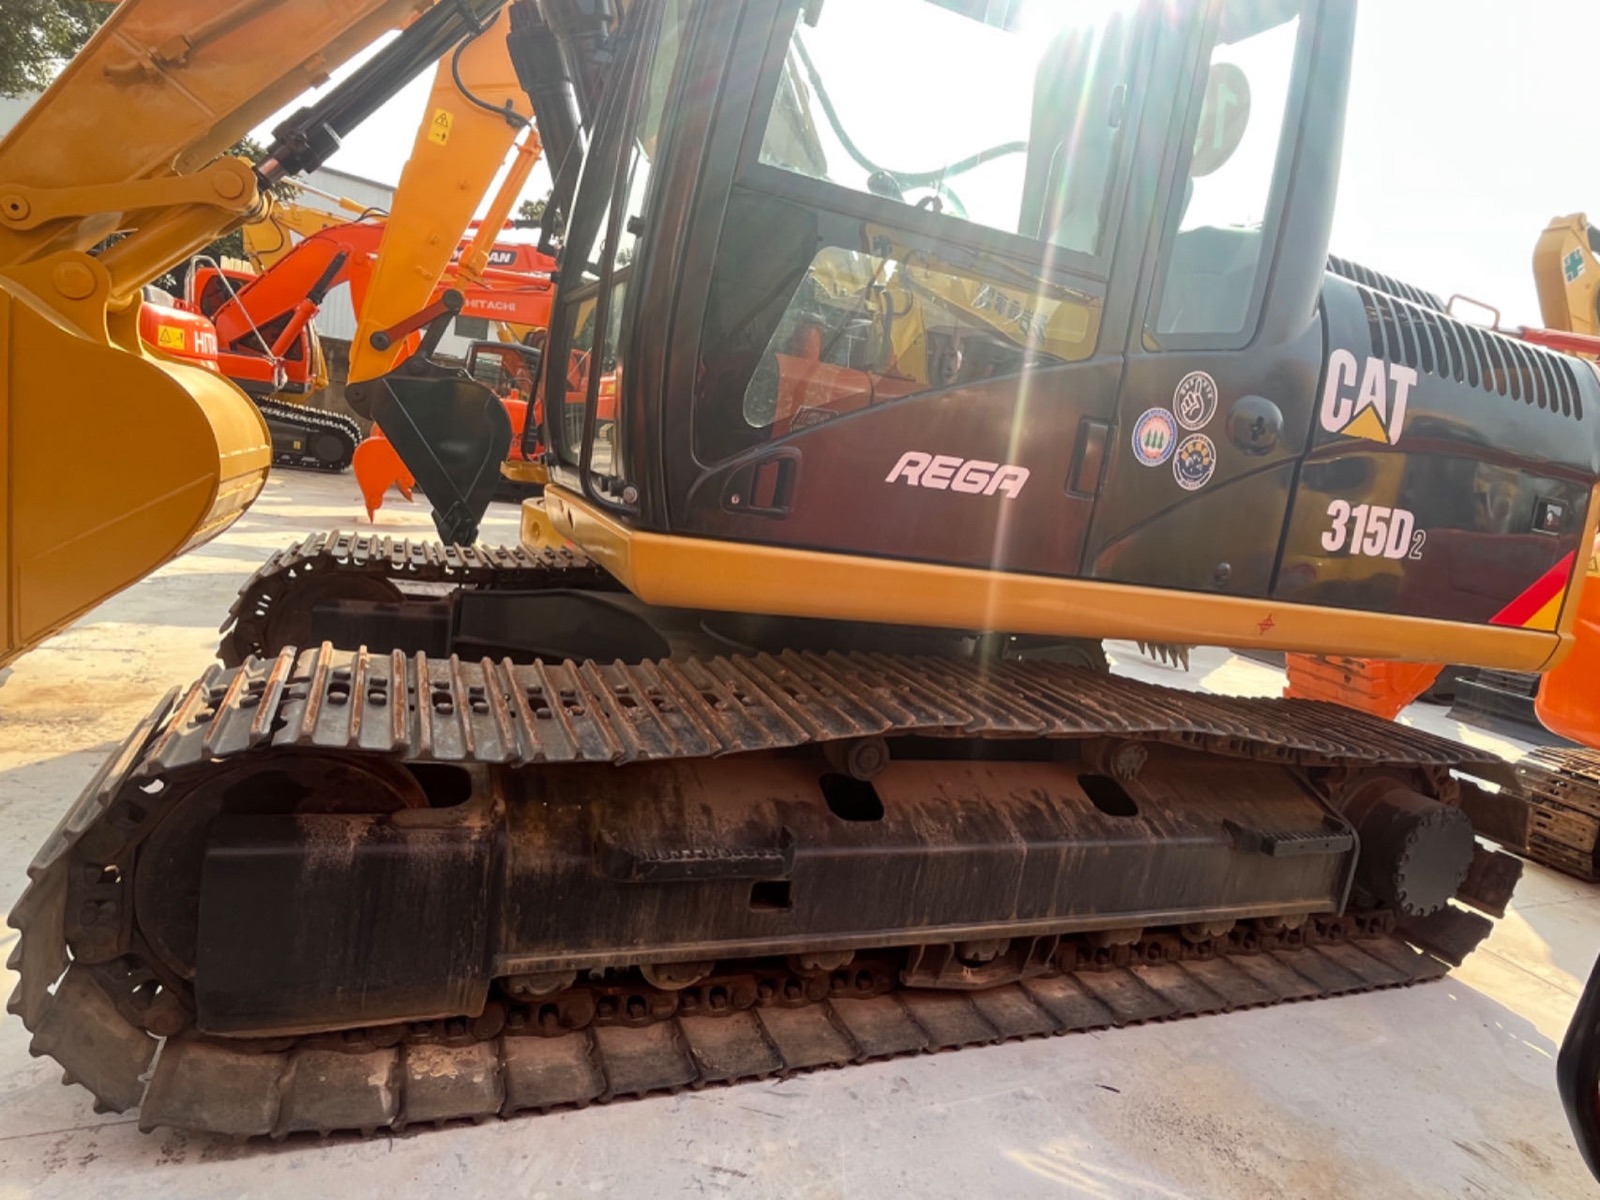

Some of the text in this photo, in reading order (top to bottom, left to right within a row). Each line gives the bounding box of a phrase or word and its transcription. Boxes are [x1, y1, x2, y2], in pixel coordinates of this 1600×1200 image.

[464, 299, 516, 311] HITACHI
[1321, 348, 1418, 446] CAT
[885, 451, 1030, 499] REGA
